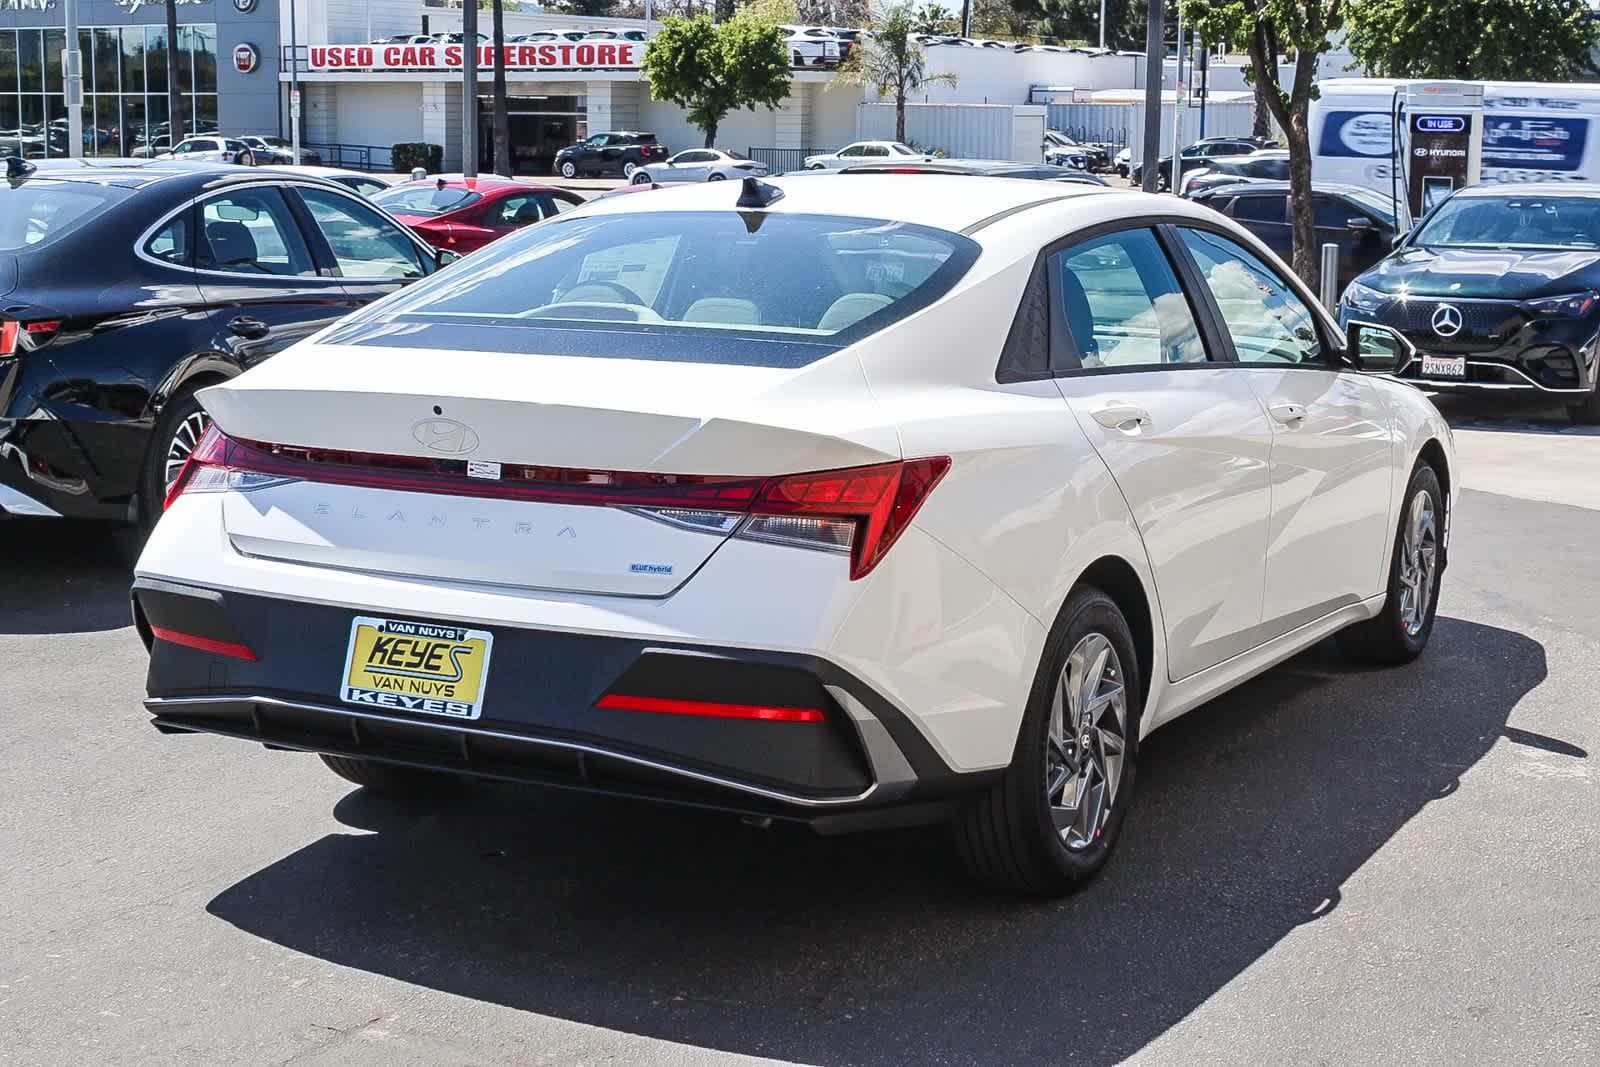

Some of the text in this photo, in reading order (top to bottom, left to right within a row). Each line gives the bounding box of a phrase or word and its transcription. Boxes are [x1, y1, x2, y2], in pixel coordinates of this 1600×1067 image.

[311, 47, 374, 67] USED
[384, 46, 436, 66] CAR
[1427, 120, 1454, 128] IN USE
[1429, 149, 1466, 157] HYUNDAI
[311, 502, 577, 539] ELANTRA
[388, 623, 455, 639] VAN NUYS
[366, 636, 474, 682] KEYES
[372, 675, 456, 697] VAN NUYS
[352, 689, 469, 716] KEYES
